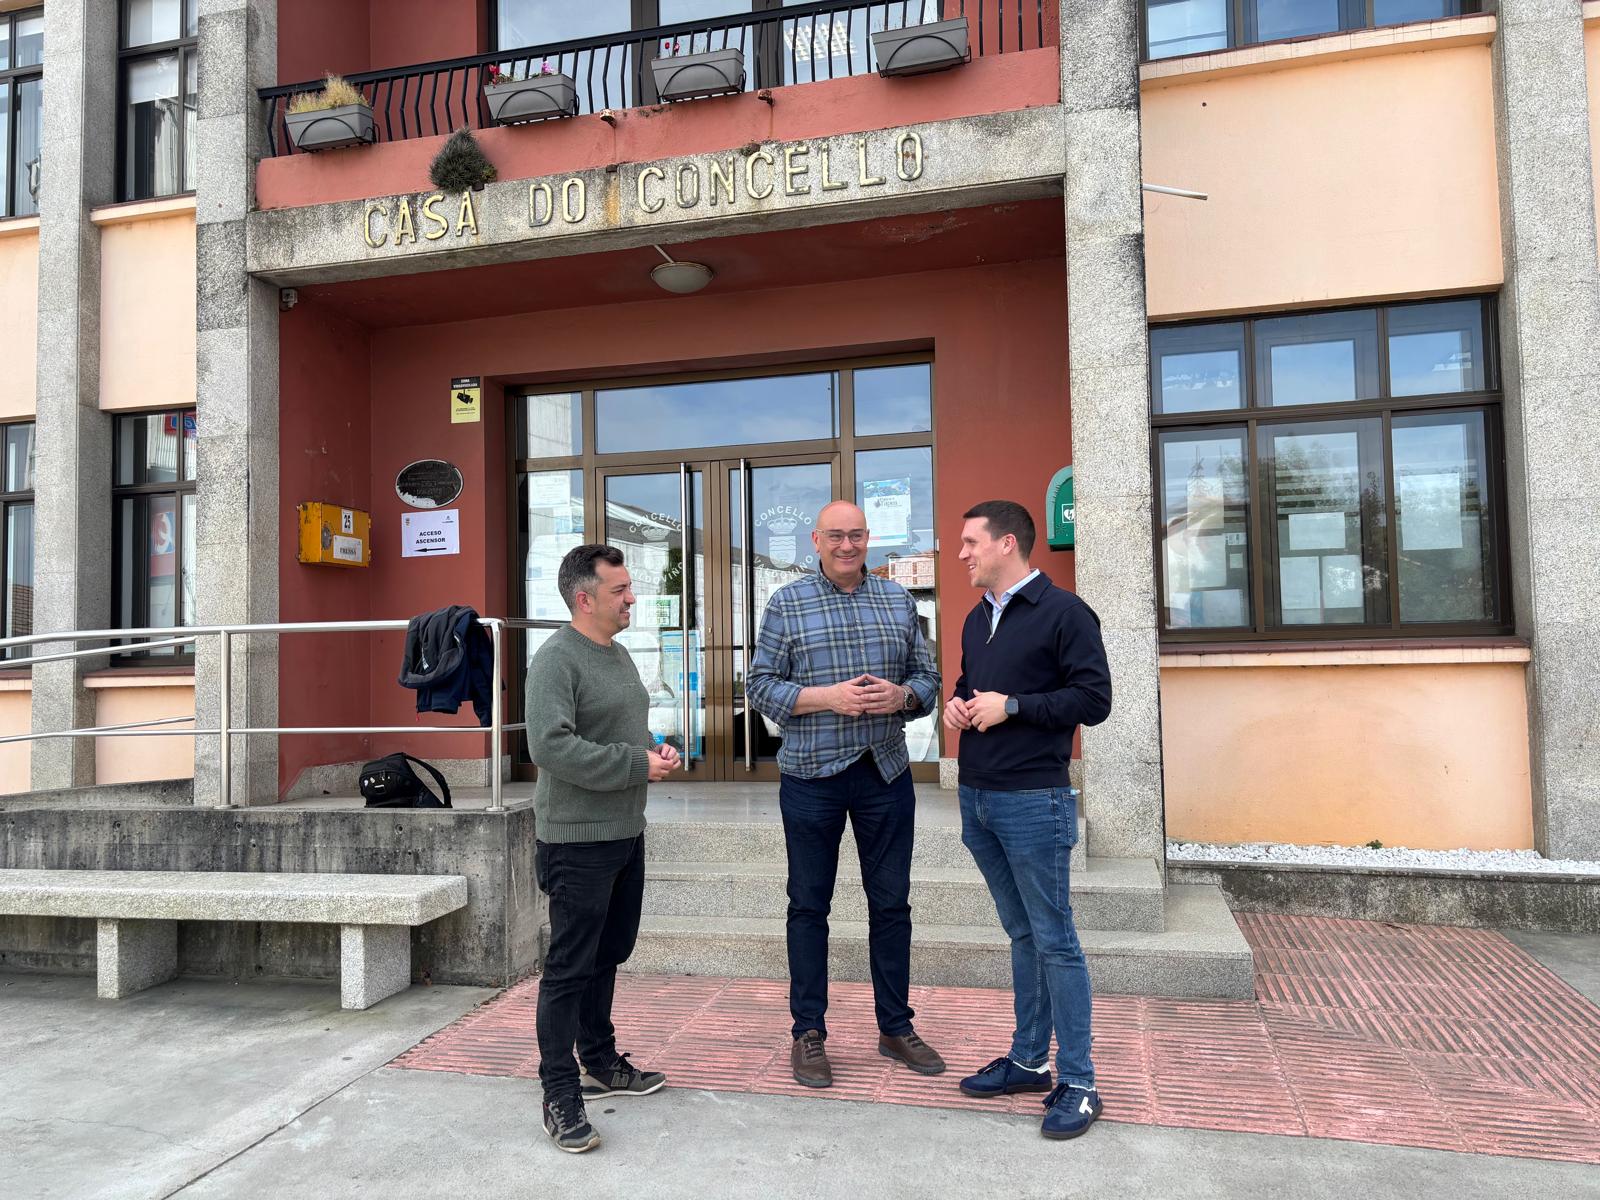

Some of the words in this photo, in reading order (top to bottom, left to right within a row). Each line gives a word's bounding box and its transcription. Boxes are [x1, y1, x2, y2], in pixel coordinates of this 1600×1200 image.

[364, 192, 479, 248] CASA
[529, 177, 587, 227] DO
[637, 132, 923, 213] CONCELLO
[754, 506, 812, 527] CONCELLO
